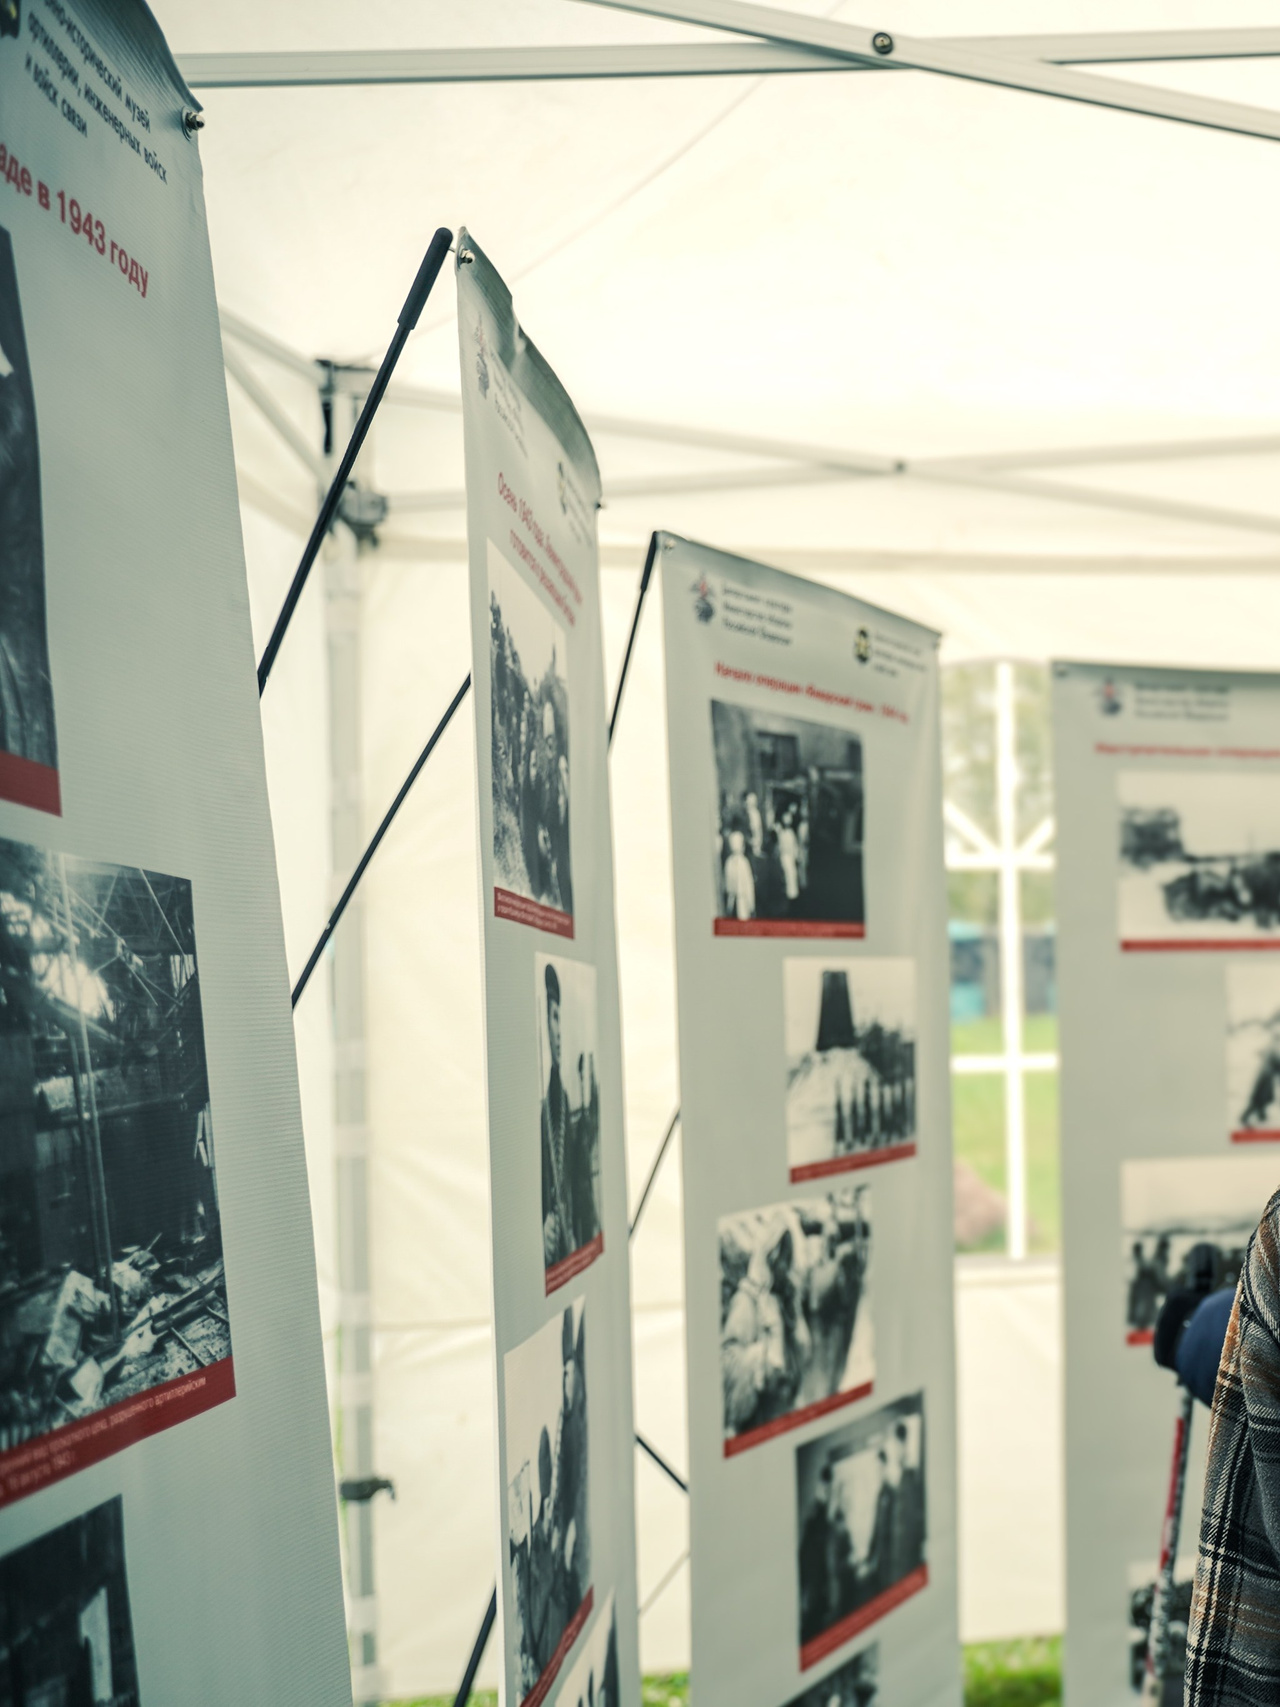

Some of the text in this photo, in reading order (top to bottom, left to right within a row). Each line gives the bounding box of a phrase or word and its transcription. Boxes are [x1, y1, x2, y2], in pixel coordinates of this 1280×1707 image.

[34, 62, 58, 108] войск
[61, 97, 88, 138] связи
[84, 82, 141, 156] инженерных
[144, 146, 168, 185] войск
[125, 93, 150, 133] музей
[37, 179, 51, 212] в
[57, 189, 106, 257] 1943
[110, 238, 149, 299] году
